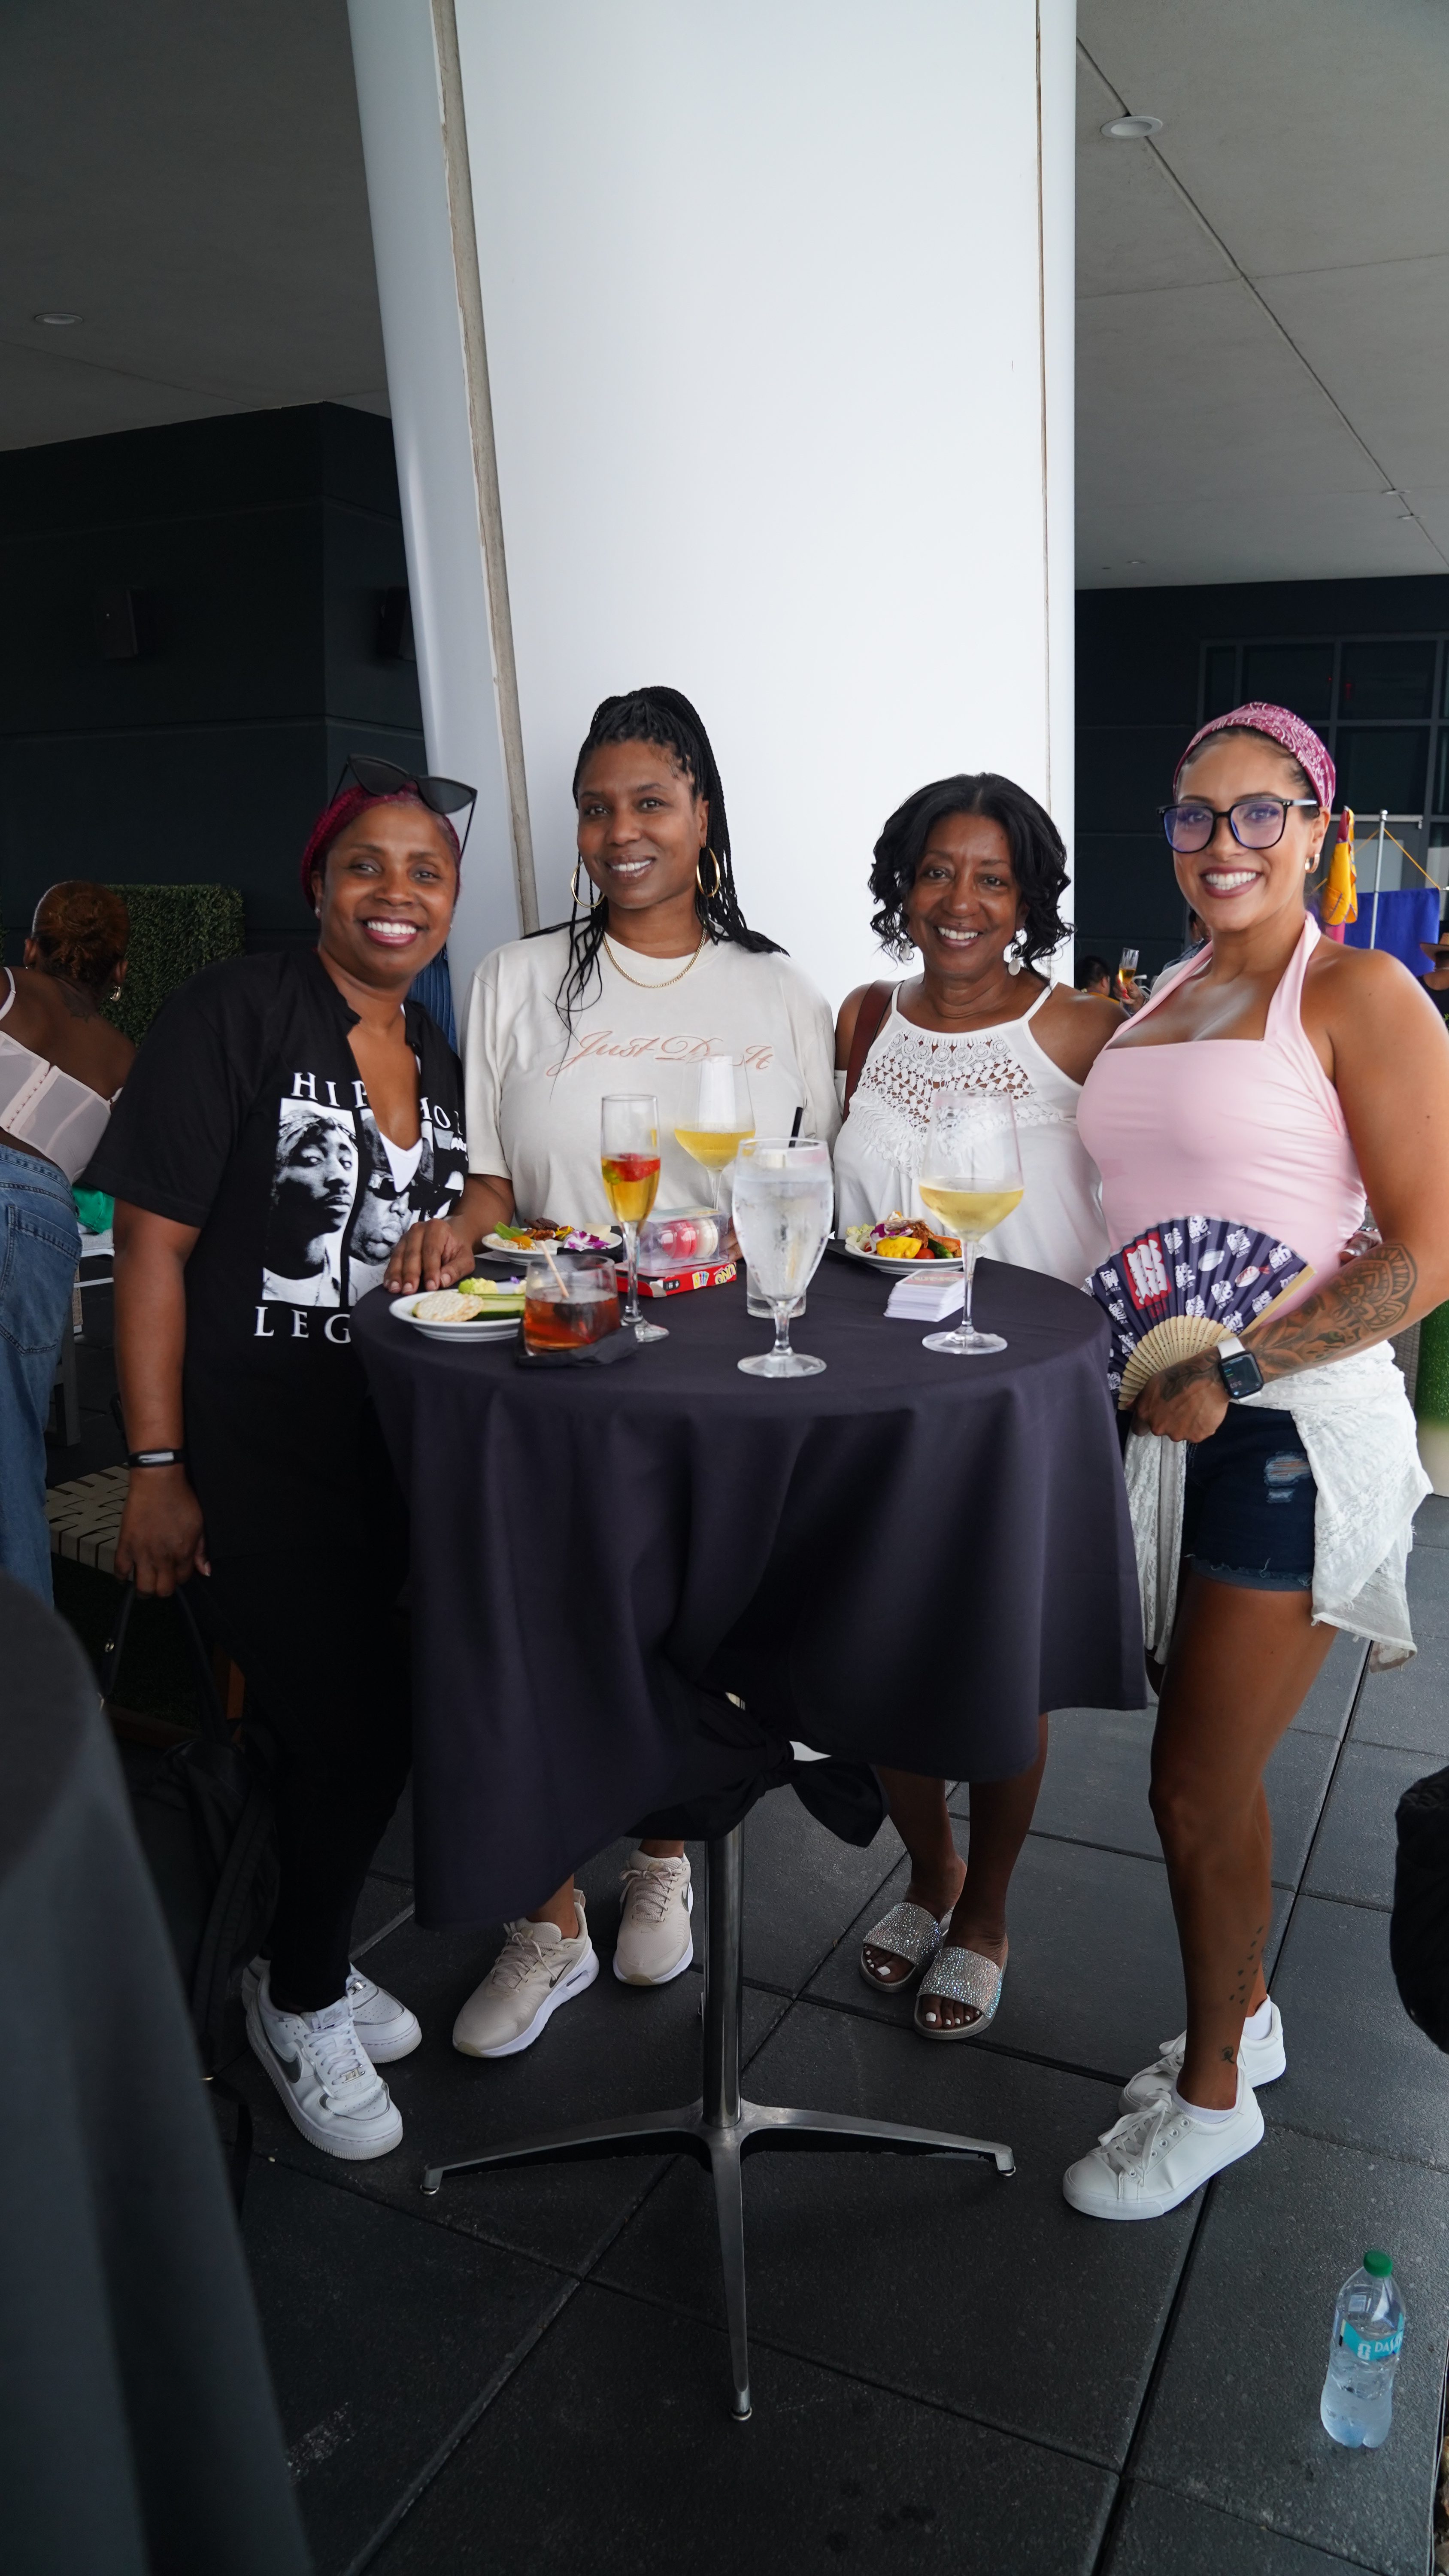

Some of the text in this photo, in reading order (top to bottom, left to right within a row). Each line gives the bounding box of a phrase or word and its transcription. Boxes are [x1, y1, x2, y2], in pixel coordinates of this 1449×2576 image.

[546, 1030, 660, 1076] Just
[730, 1045, 774, 1070] It
[290, 1071, 368, 1108] HIP
[715, 1263, 737, 1285] UNO
